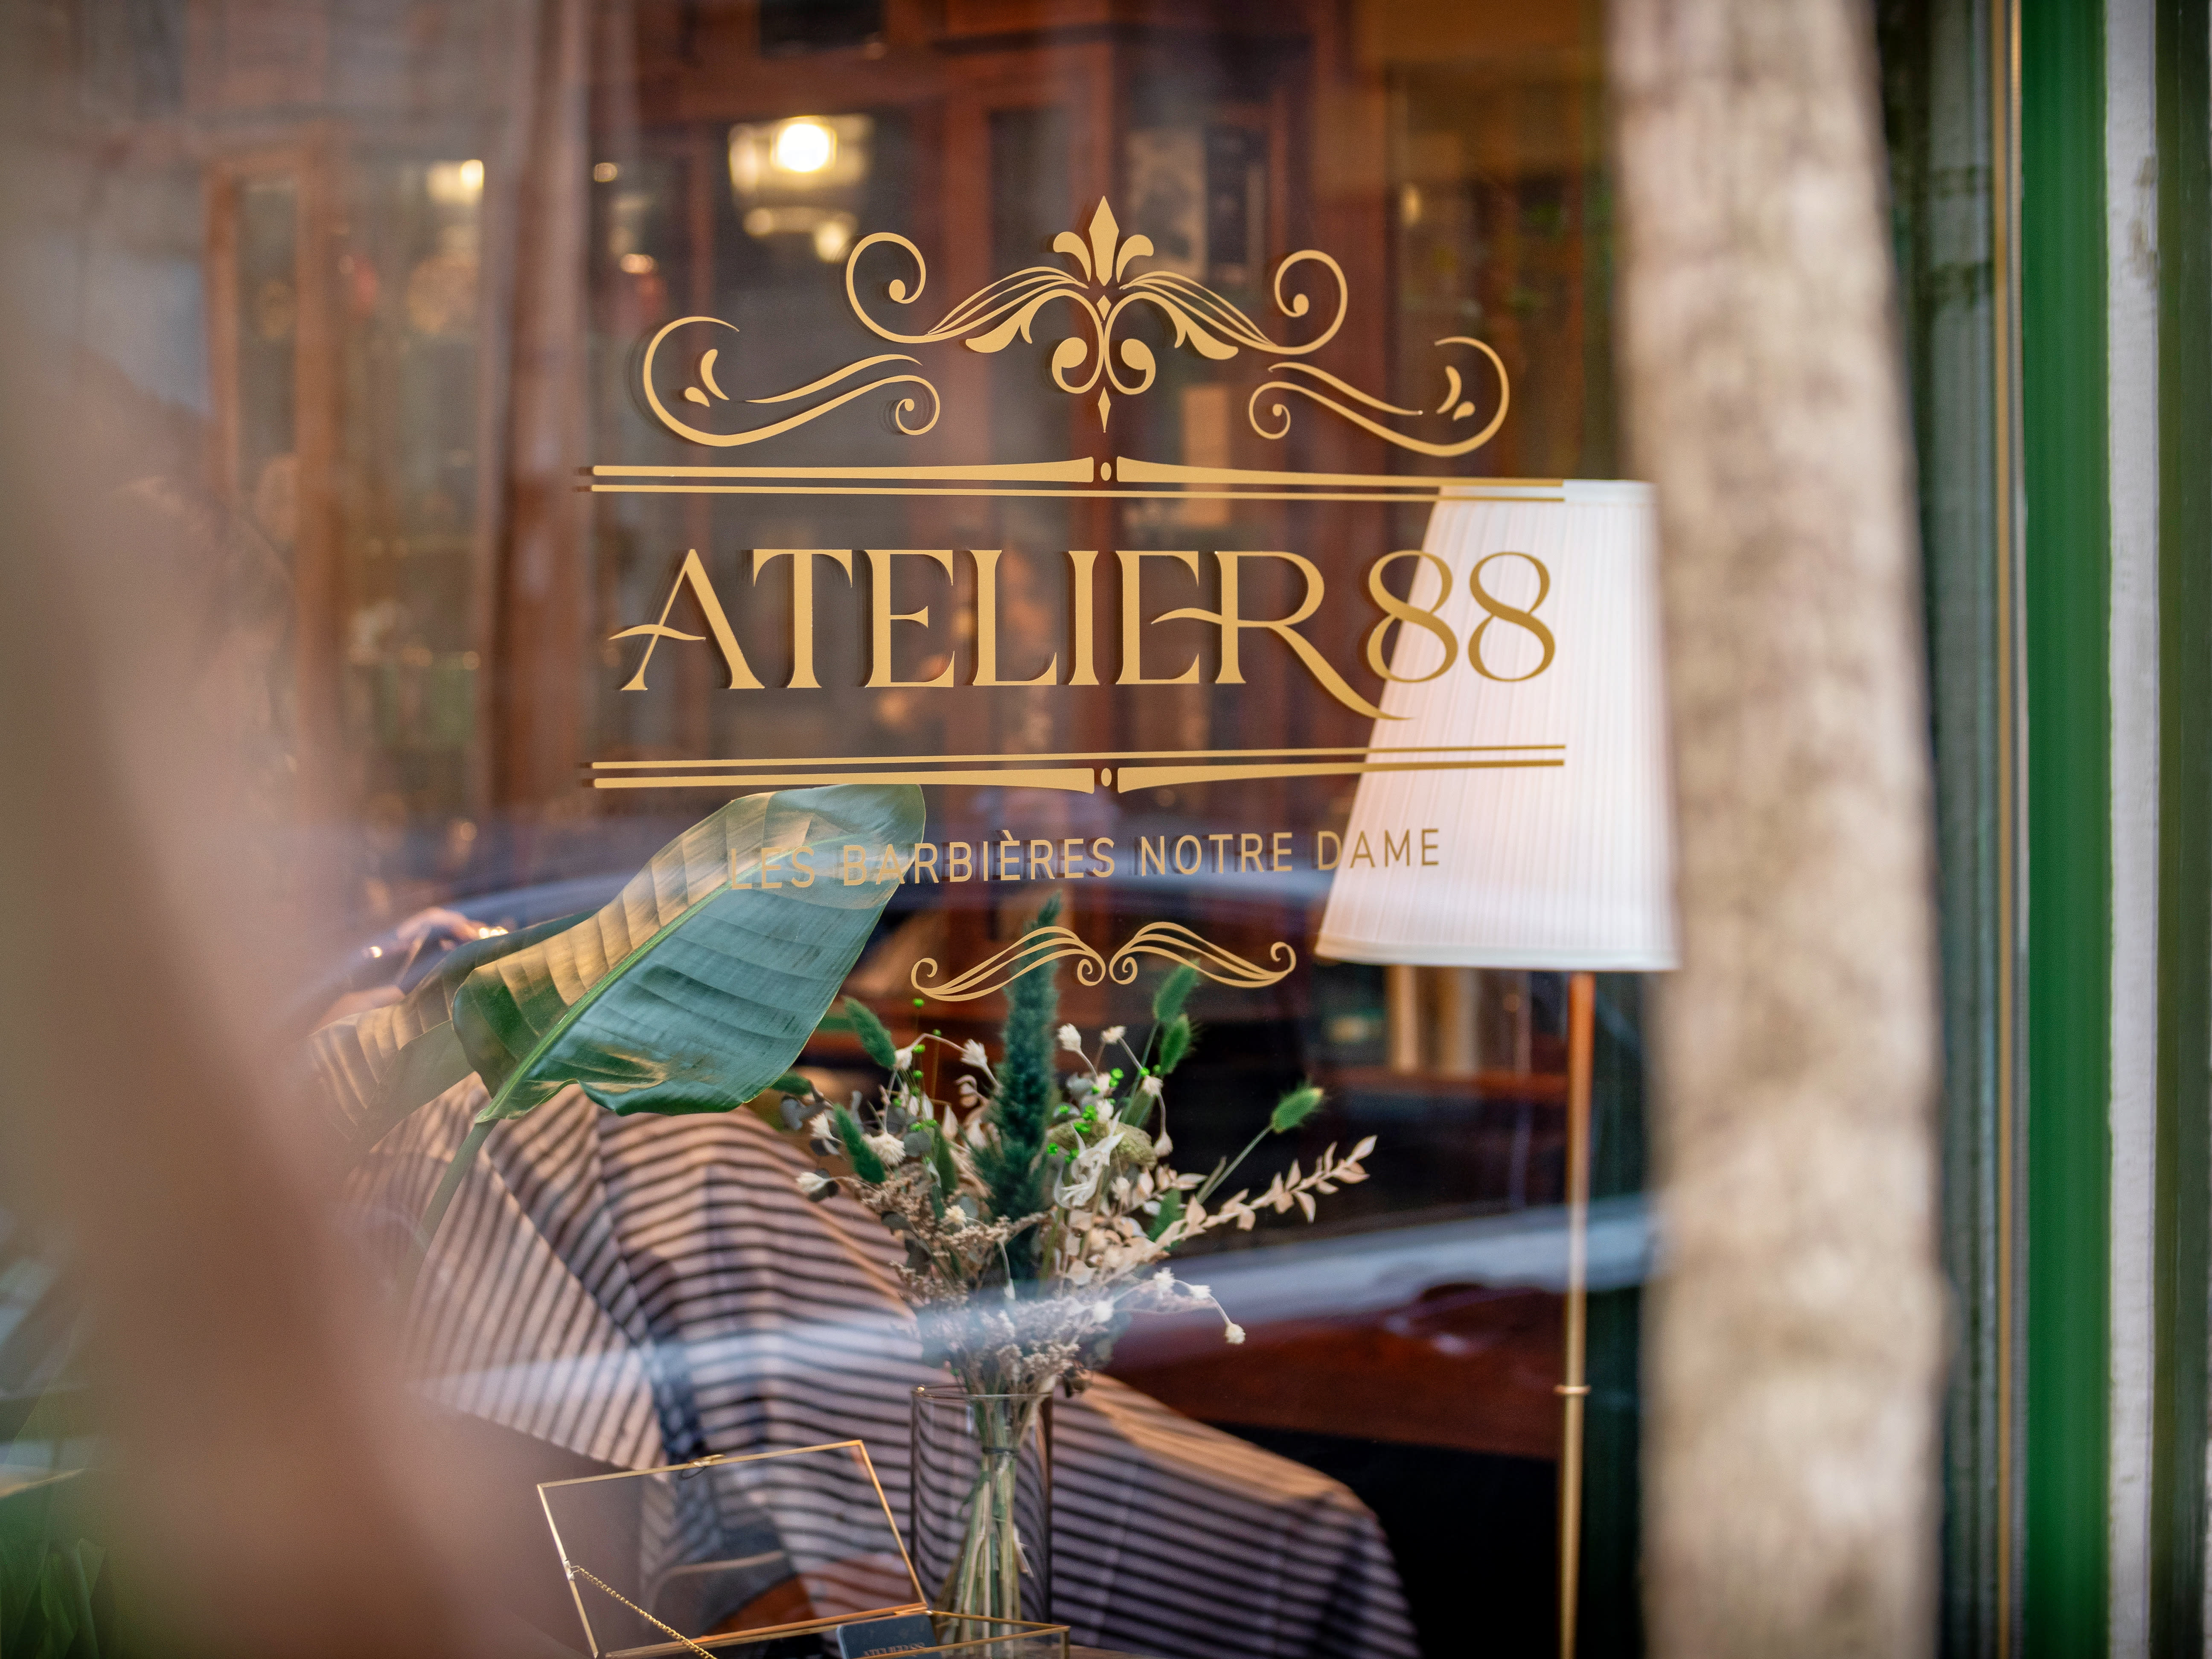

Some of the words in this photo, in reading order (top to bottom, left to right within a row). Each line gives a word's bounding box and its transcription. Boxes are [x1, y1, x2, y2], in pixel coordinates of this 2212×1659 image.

[608, 548, 1416, 721] ATELIER
[1367, 549, 1557, 684] 88
[731, 846, 815, 890] LES
[843, 829, 1115, 886] BARBIÈRES
[1141, 831, 1293, 876] NOTRE
[1317, 828, 1439, 871] DAME
